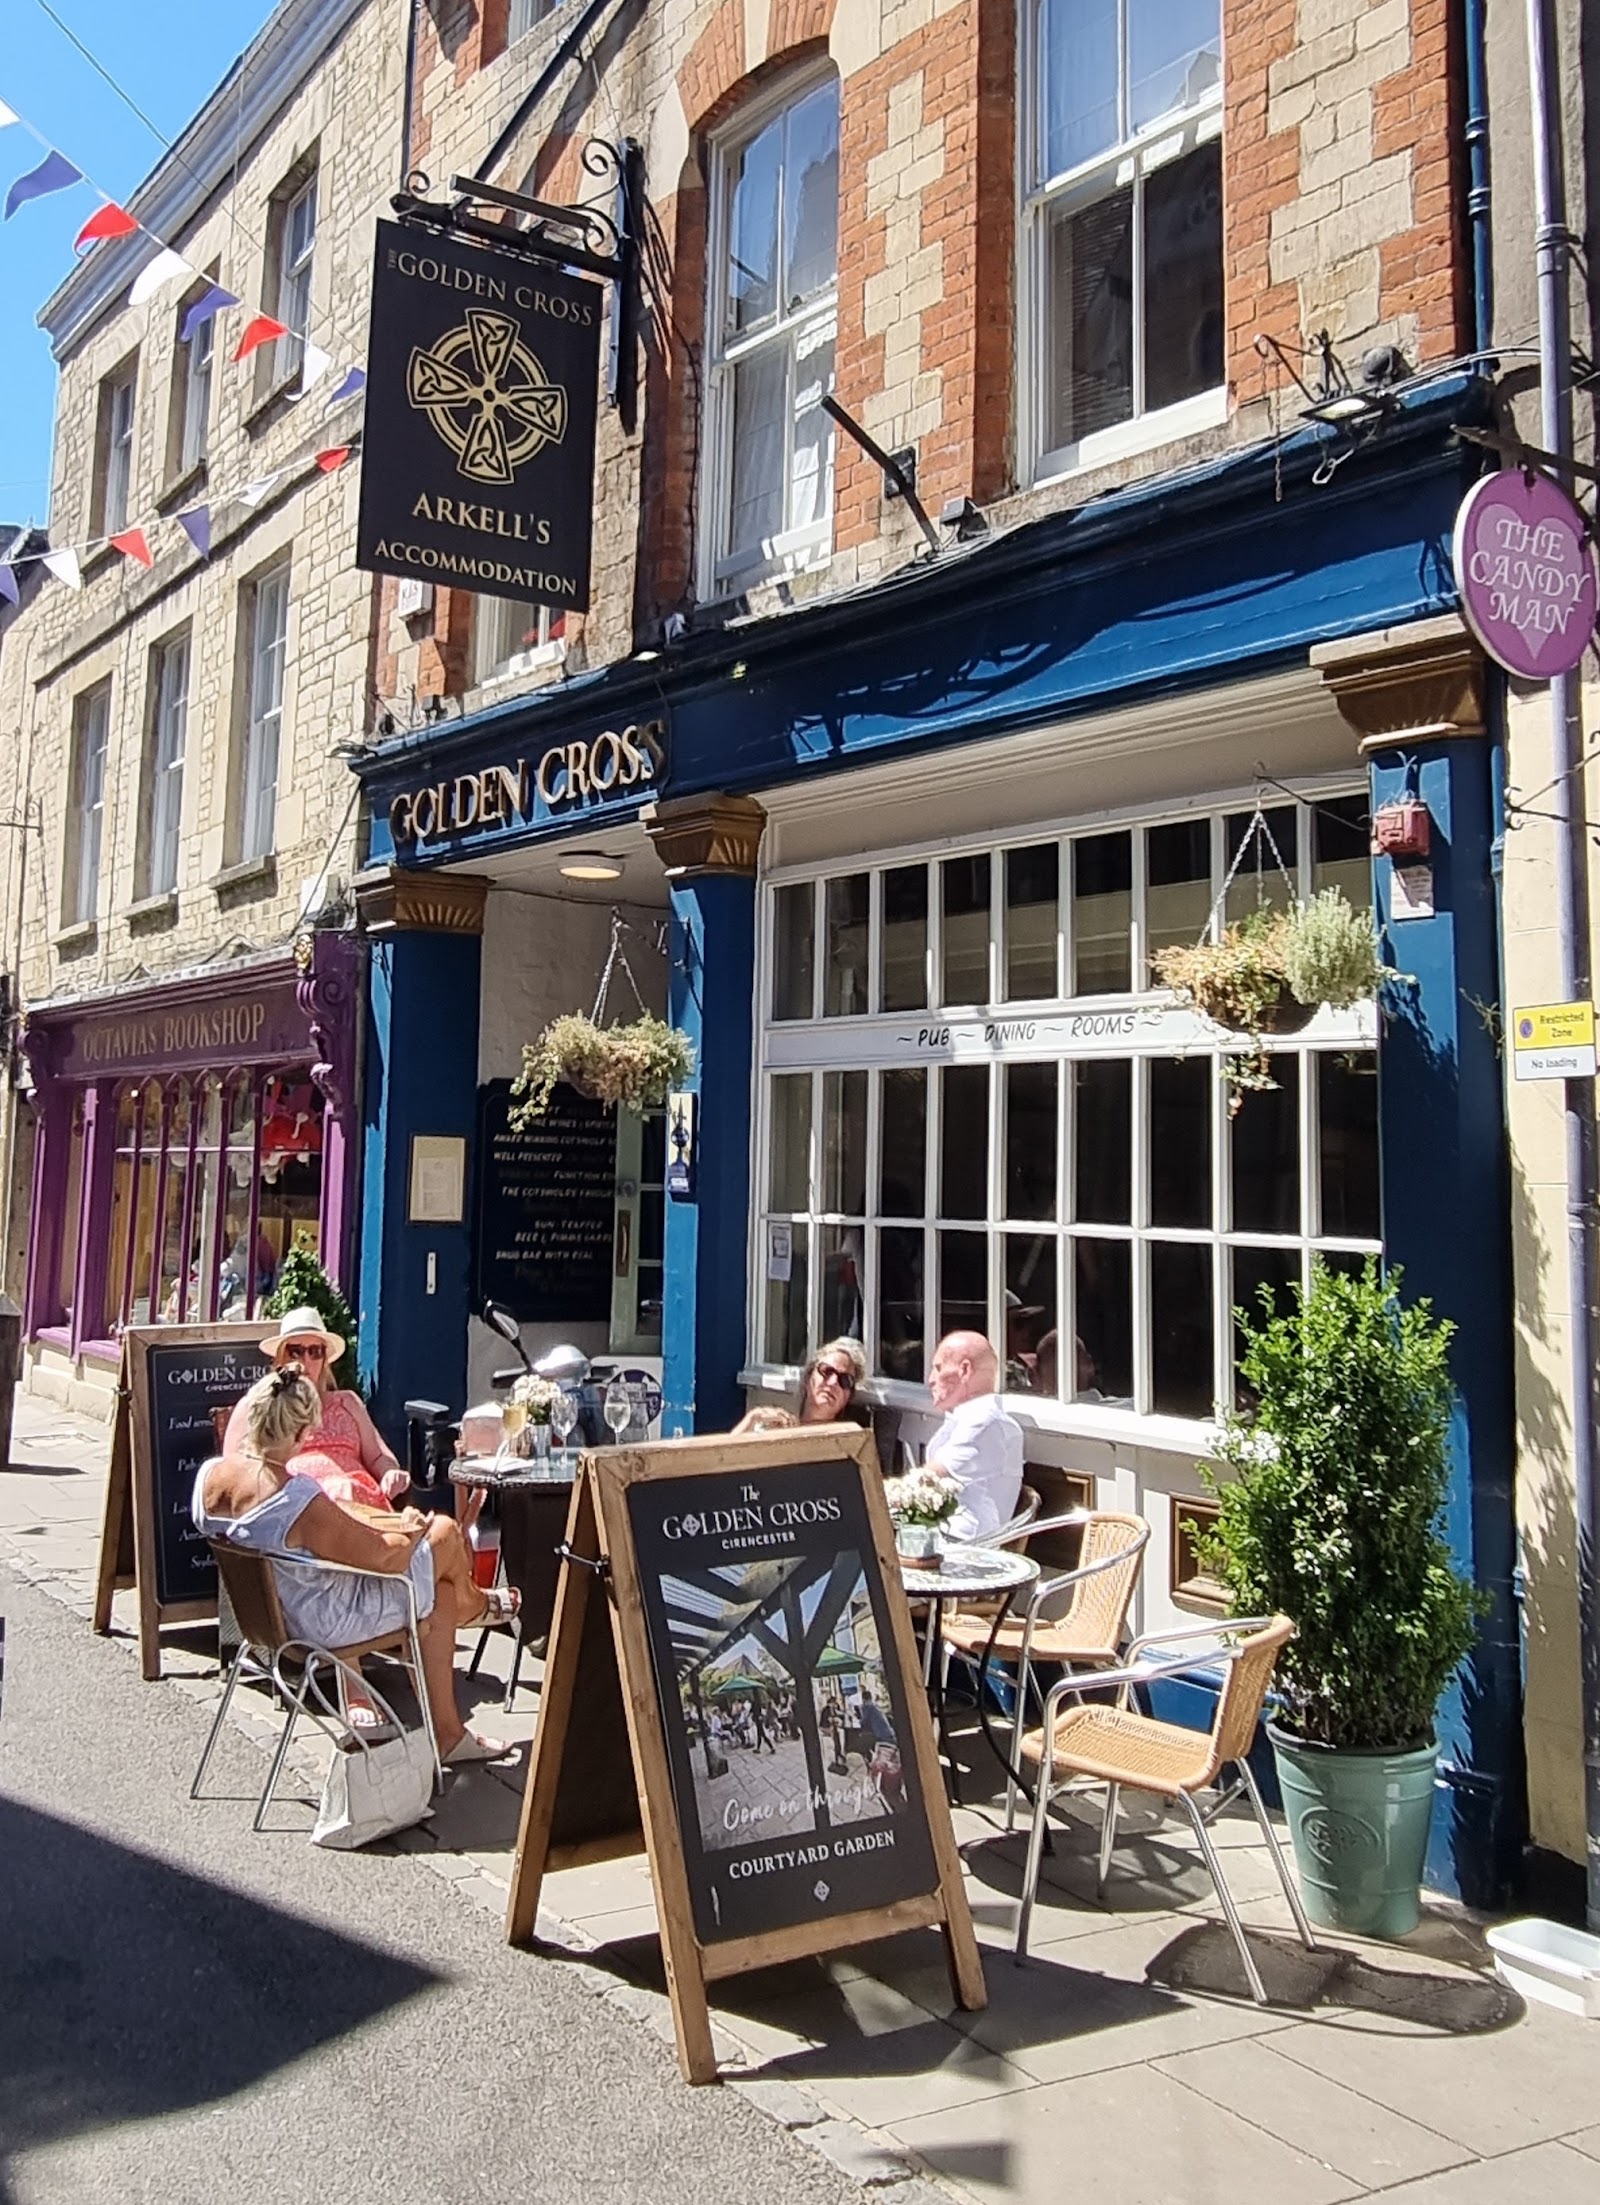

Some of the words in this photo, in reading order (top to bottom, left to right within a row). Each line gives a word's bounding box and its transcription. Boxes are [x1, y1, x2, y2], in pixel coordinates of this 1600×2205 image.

[398, 252, 507, 301] GOLDEN
[514, 287, 593, 327] CROSS
[411, 493, 551, 545] ARKELL'S
[1495, 519, 1565, 562] THE
[374, 539, 577, 596] ACCOMMODATION
[1469, 550, 1592, 603] CANDY
[1488, 592, 1575, 635] MAN
[390, 759, 530, 842] GOLDEN
[538, 721, 666, 804] CROSS
[163, 1003, 265, 1052] BOOKSHOP
[917, 1027, 951, 1047] PUB
[984, 1022, 1036, 1043] DINING
[1070, 1016, 1136, 1038] ROOMS
[1540, 1012, 1584, 1024] Restricted
[1552, 1027, 1572, 1038] Zone
[1531, 1059, 1544, 1069] No
[493, 1152, 515, 1162] WELL
[517, 1152, 563, 1163] PRESENTED
[502, 1186, 518, 1196] THE
[514, 1232, 540, 1243] BEER
[522, 1250, 541, 1260] BAR
[544, 1250, 570, 1260] WITH
[223, 1353, 237, 1366] The
[168, 1367, 236, 1386] GOLDEN
[740, 1483, 760, 1503] The
[662, 1506, 764, 1540] GOLDEN
[769, 1497, 842, 1527] CROSS
[721, 1530, 797, 1550] CIRENCESTER
[723, 1798, 773, 1831] Come
[779, 1801, 800, 1817] on
[729, 1844, 830, 1879] COURTYARD
[834, 1829, 895, 1857] GARDEN
